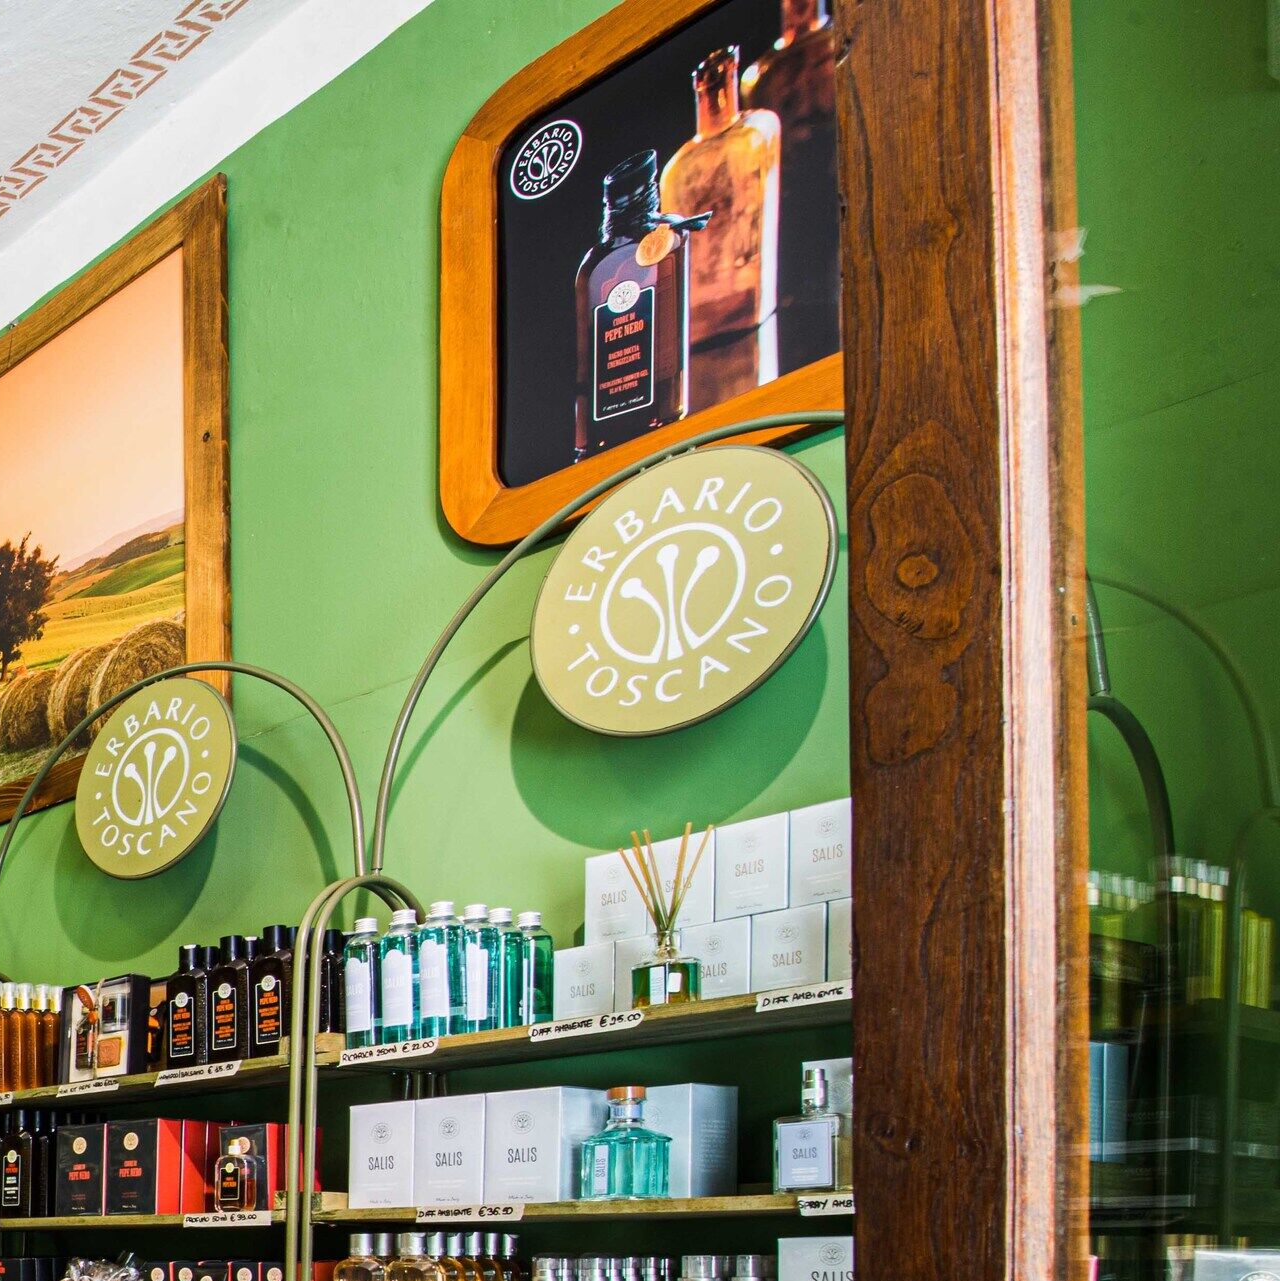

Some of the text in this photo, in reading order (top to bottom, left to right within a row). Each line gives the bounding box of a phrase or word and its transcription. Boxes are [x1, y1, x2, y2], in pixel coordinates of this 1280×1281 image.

[518, 127, 571, 169] ERBARIO
[518, 150, 574, 194] TOSCANO
[604, 319, 644, 343] PEPE NERO
[564, 475, 784, 604] ERBARIO
[565, 573, 793, 706] TOSCANO
[95, 696, 212, 778] ERBARIO
[93, 768, 213, 858] TOSCANO
[812, 844, 844, 863] SALIS
[734, 859, 765, 878] SALIS
[601, 890, 628, 907] SALIS
[772, 951, 803, 968] SALIS
[700, 962, 728, 979] SALIS
[570, 983, 595, 999] SALIS
[368, 1155, 394, 1171] SALIS
[435, 1151, 463, 1167] SALIS
[507, 1147, 537, 1163] SALIS
[792, 1147, 817, 1160] SALIS
[595, 1158, 605, 1178] SALIS
